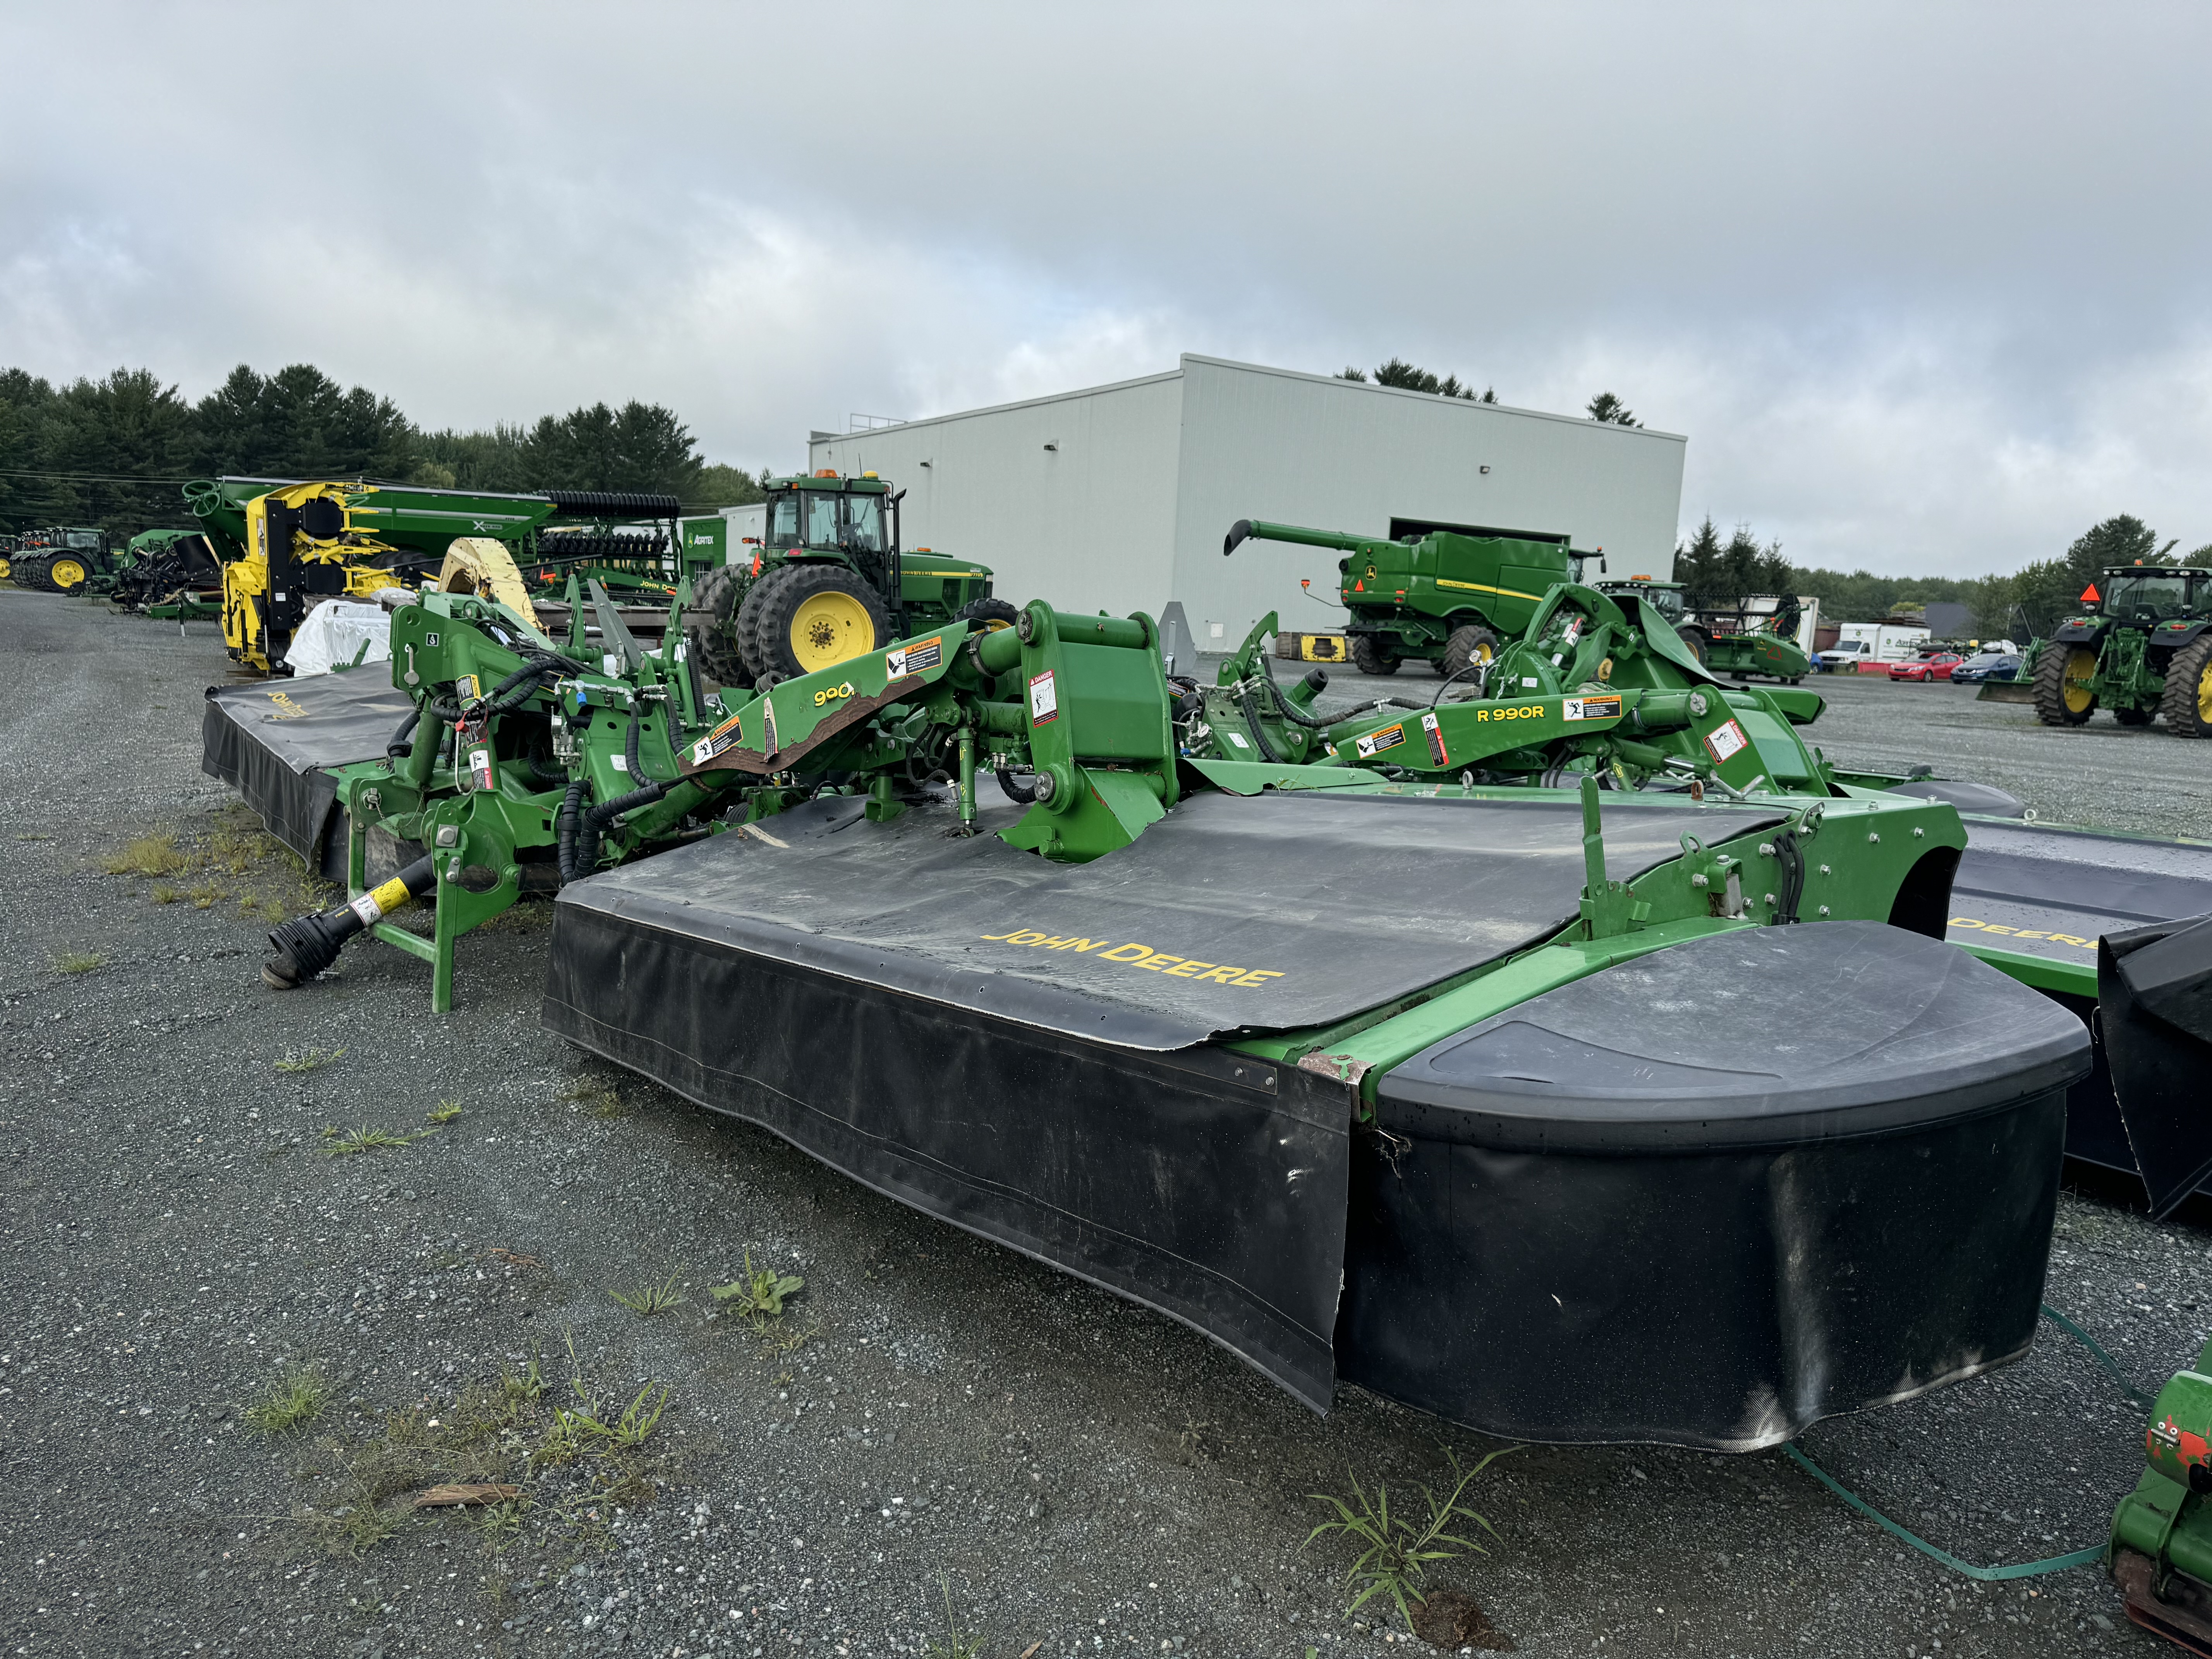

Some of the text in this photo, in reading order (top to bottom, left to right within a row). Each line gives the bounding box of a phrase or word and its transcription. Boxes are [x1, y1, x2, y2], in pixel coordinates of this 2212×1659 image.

[694, 534, 713, 545] AGRITEX
[640, 580, 659, 589] JOHN
[914, 641, 933, 649] WARNING
[1035, 670, 1052, 683] DANGER
[1477, 706, 1544, 722] R 990R
[979, 929, 1285, 987] JOHN DEERE
